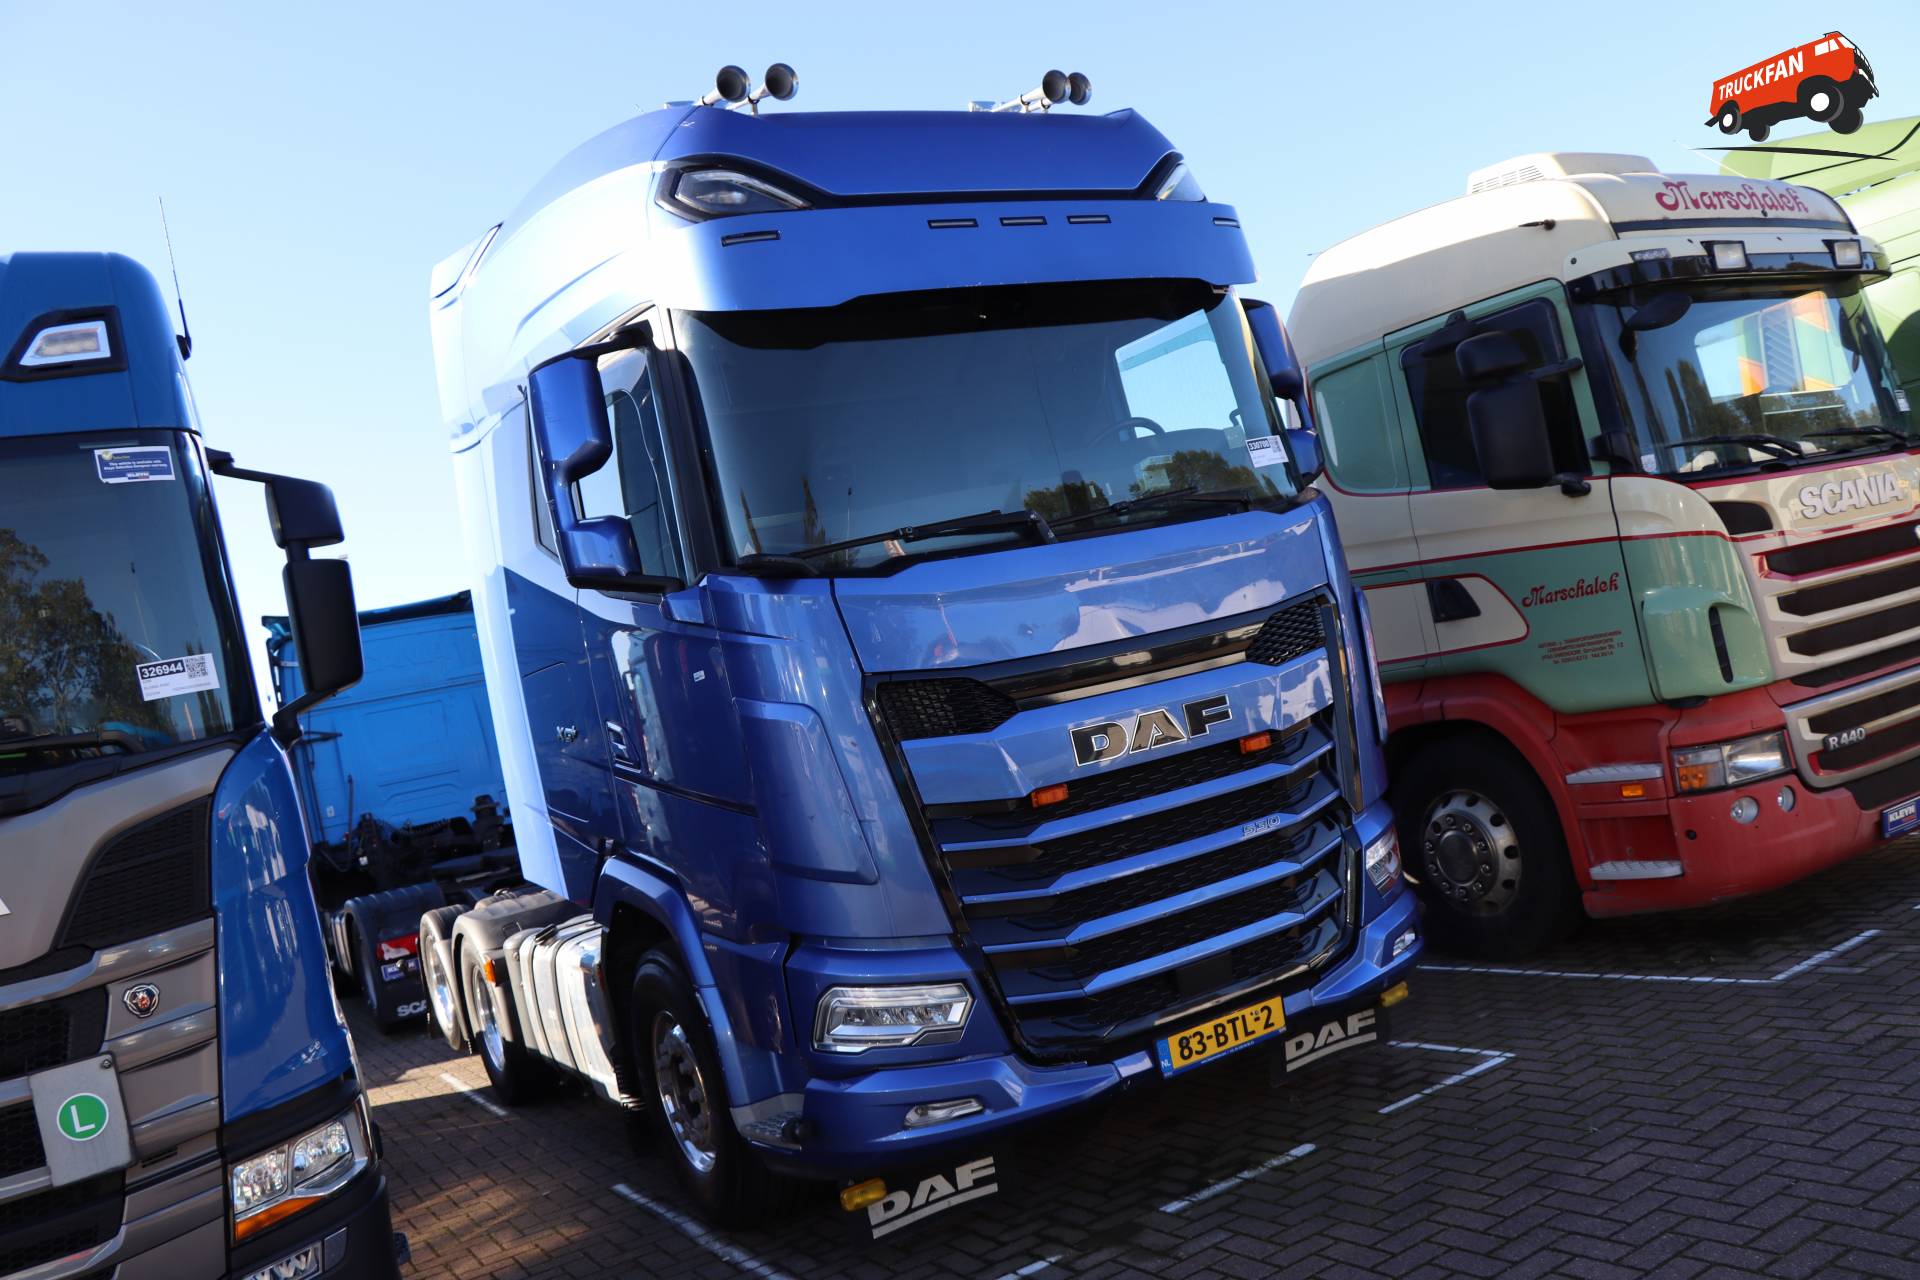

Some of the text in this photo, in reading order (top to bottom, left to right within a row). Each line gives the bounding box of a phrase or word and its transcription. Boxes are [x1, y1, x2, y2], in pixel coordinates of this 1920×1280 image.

[1799, 473, 1904, 520] SCANIA
[141, 662, 184, 678] 326944
[1069, 694, 1233, 768] DAF
[1828, 727, 1866, 751] R 440
[1243, 815, 1281, 836] 530
[1178, 1005, 1275, 1061] 83-BTL-2
[1285, 1008, 1377, 1061] DAF
[1161, 1059, 1171, 1069] NL
[68, 1104, 95, 1133] L
[867, 1156, 997, 1226] DAF
